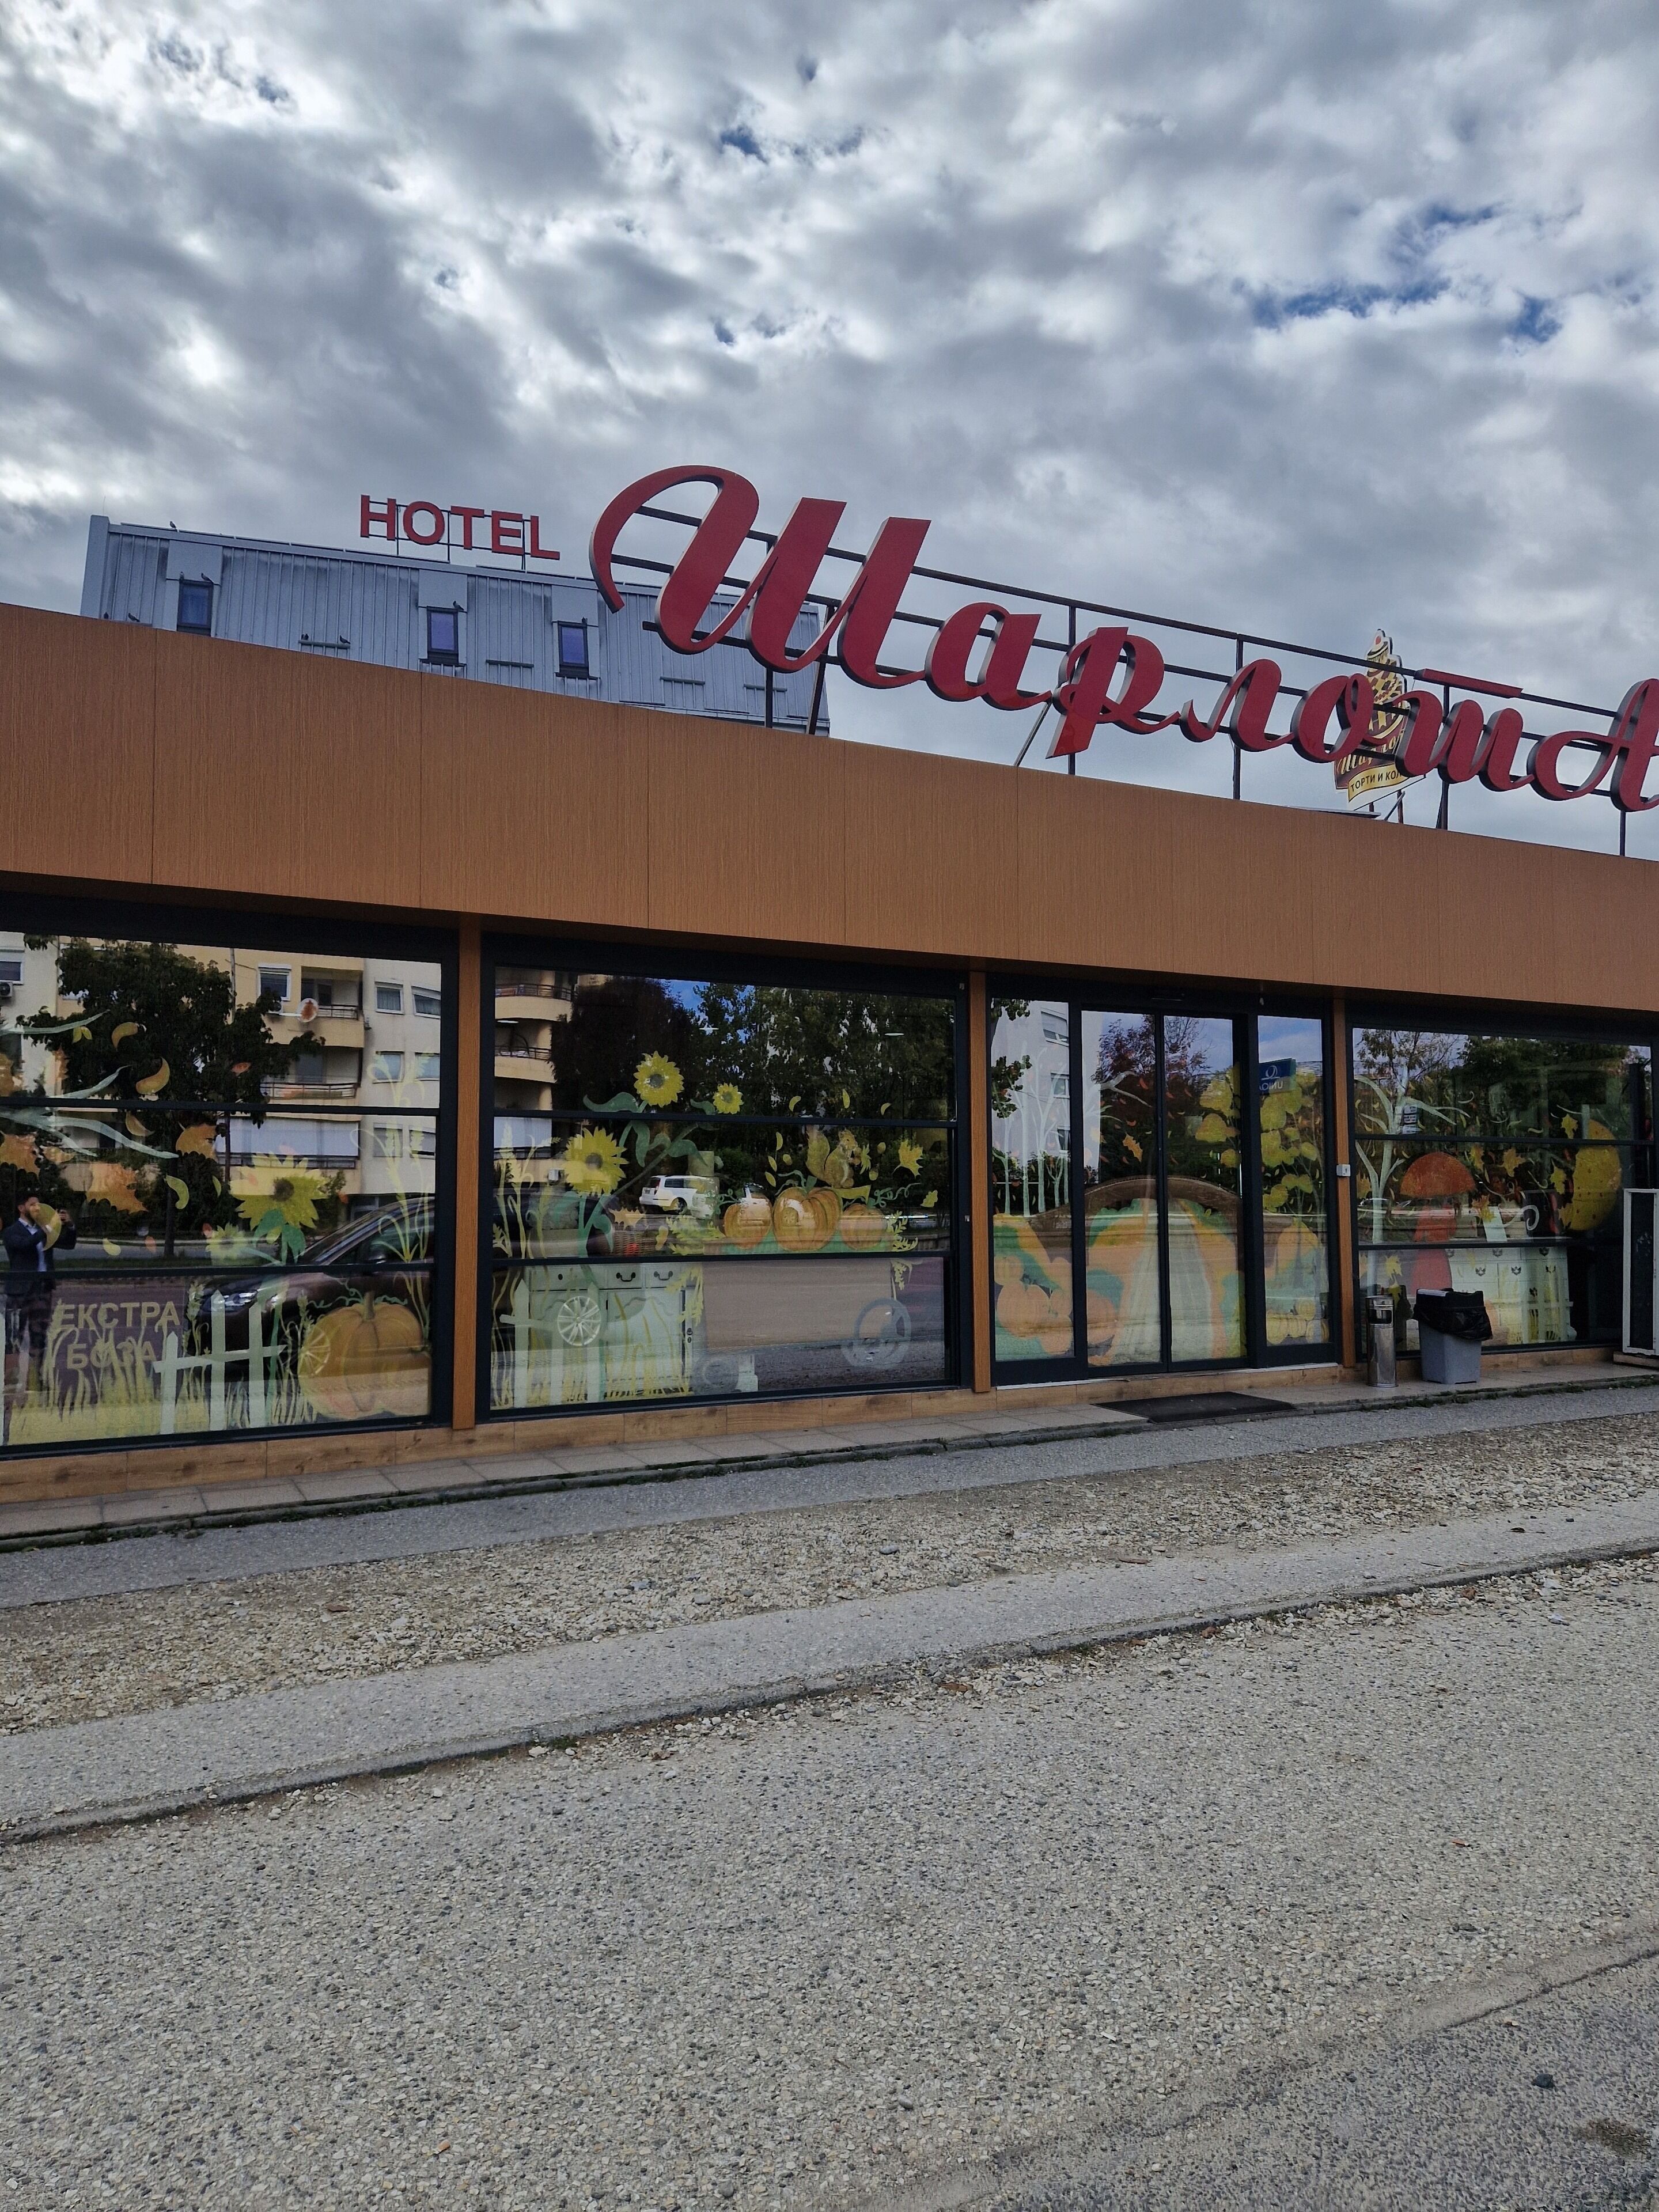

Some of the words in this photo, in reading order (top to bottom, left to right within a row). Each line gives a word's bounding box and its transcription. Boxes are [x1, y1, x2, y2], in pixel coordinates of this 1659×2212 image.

[360, 494, 560, 560] HOTEL
[1351, 775, 1375, 791] ТОРТИ
[1377, 772, 1383, 782] И
[57, 1301, 180, 1330] ЕКСТРА
